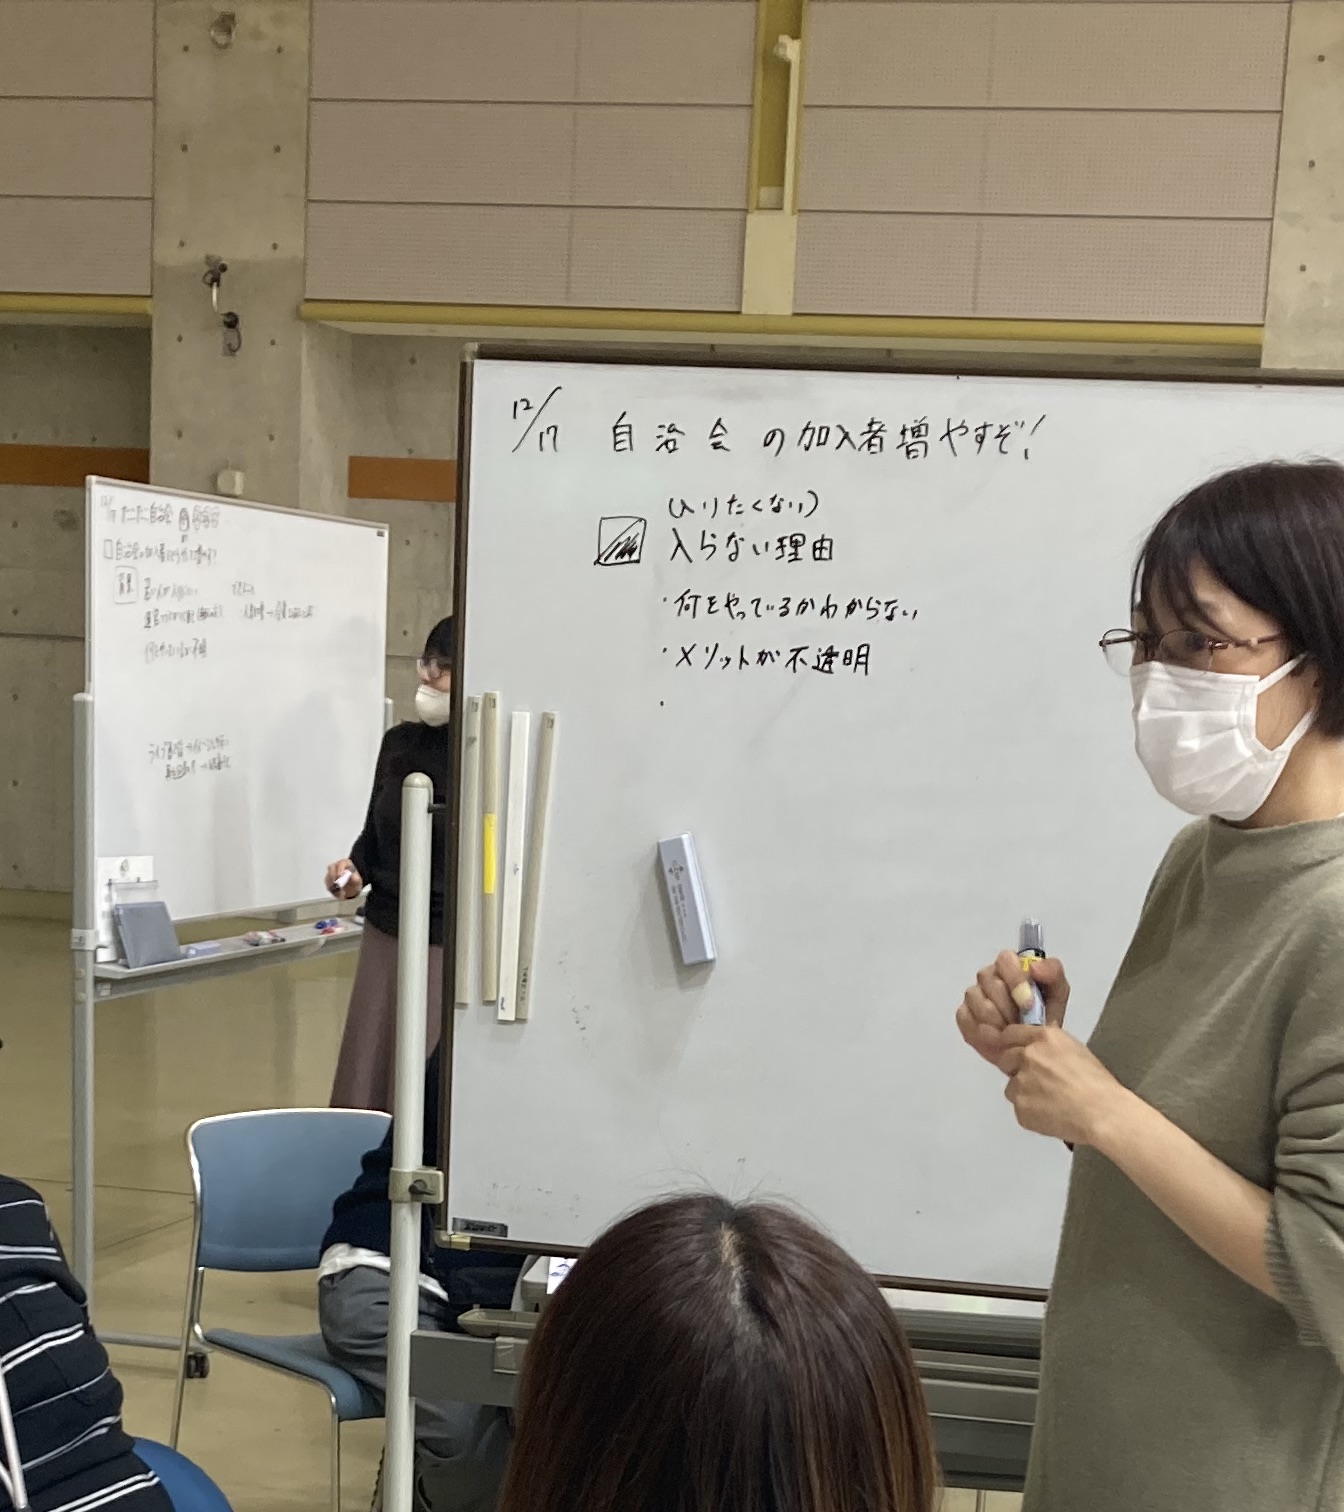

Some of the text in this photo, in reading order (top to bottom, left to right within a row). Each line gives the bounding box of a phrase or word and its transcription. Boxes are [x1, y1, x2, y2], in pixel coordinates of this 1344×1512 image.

[669, 527, 835, 564] 入らない理由
